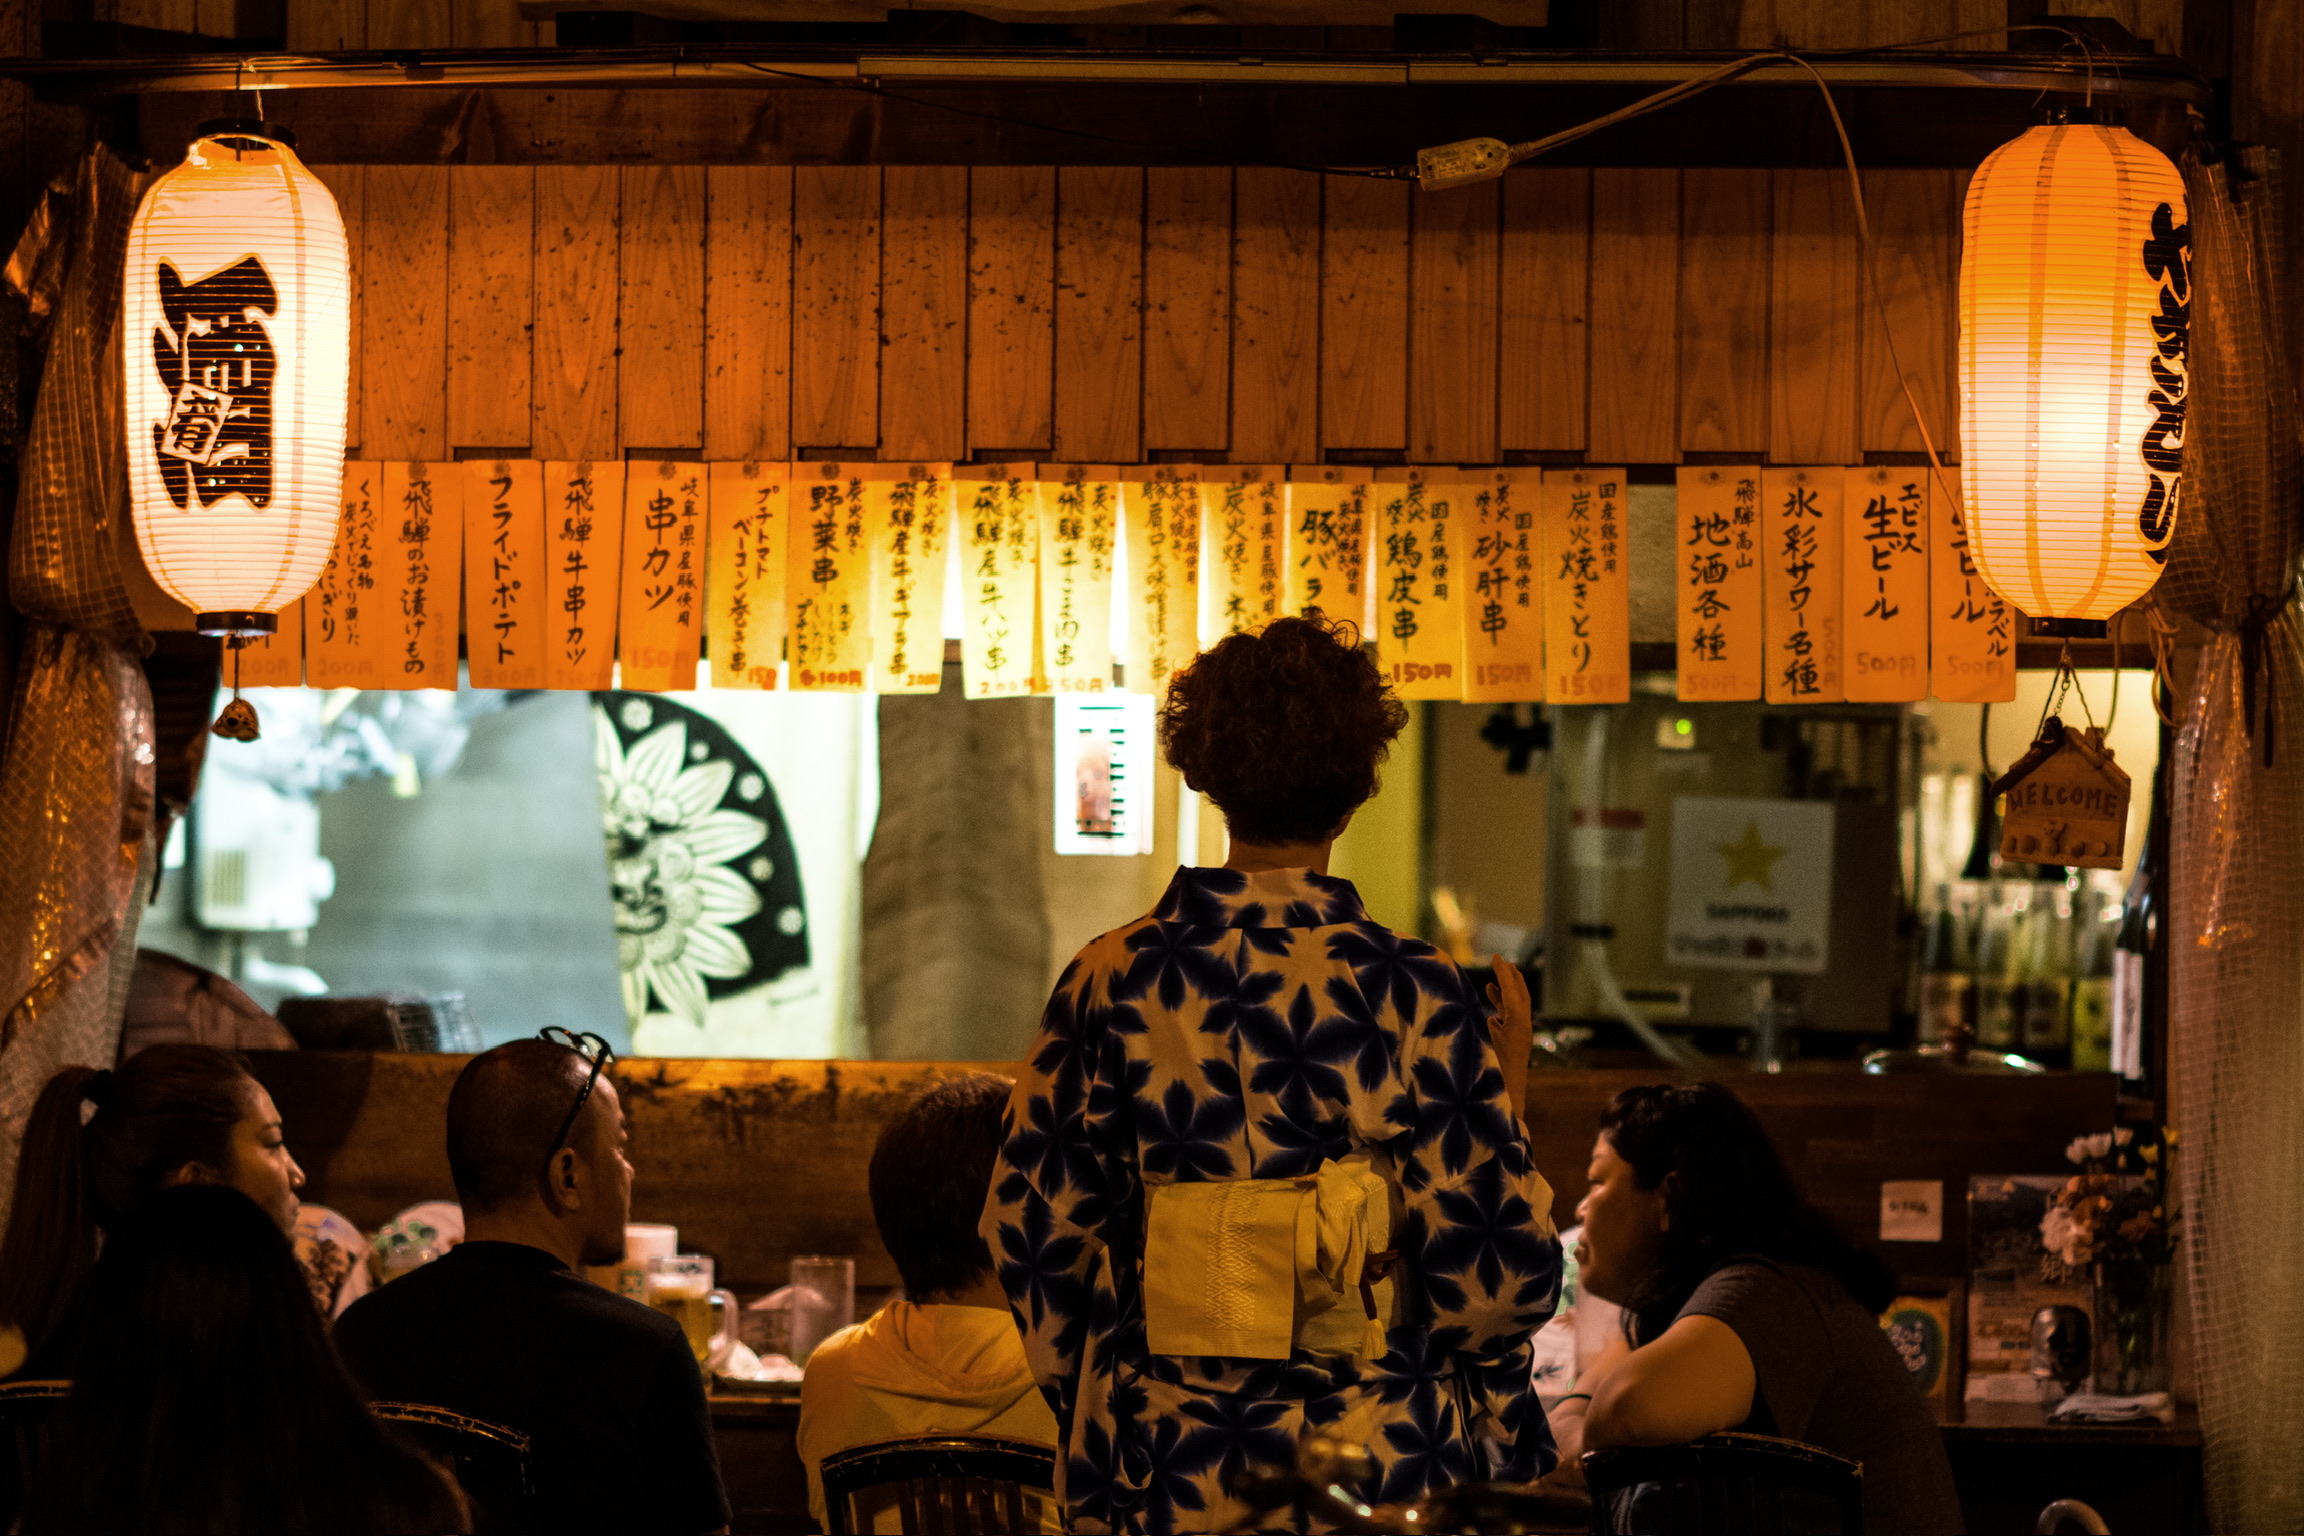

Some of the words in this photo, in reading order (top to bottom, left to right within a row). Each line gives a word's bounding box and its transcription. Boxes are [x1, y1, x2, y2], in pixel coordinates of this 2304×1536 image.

[399, 479, 432, 675] 飛騨のお漬けもの
[489, 476, 521, 665] フライドポテト
[559, 477, 595, 667] 飛騨牛串カツ
[642, 488, 678, 611] 串カツ
[676, 476, 700, 628] 岐阜県産豚使用
[755, 484, 780, 580] プチトマト
[810, 484, 844, 592] 野菜串
[1598, 482, 1619, 575] 国産鶏使用
[1733, 478, 1757, 570] 飛騨高山
[1862, 494, 1903, 622] 生ビール
[1897, 482, 1924, 555] エビス
[728, 517, 753, 678] ベーコン巻き串
[1385, 530, 1424, 653] 鶏皮串
[1472, 530, 1514, 647] 砂肝串
[1558, 488, 1600, 673] 炭火焼きとり
[1687, 511, 1732, 662] 地酒各種
[630, 647, 690, 670] 150円
[1392, 662, 1453, 683] 150円
[1476, 662, 1534, 687] 150円
[1856, 651, 1917, 680] 500円
[2007, 780, 2118, 819] WELCOME
